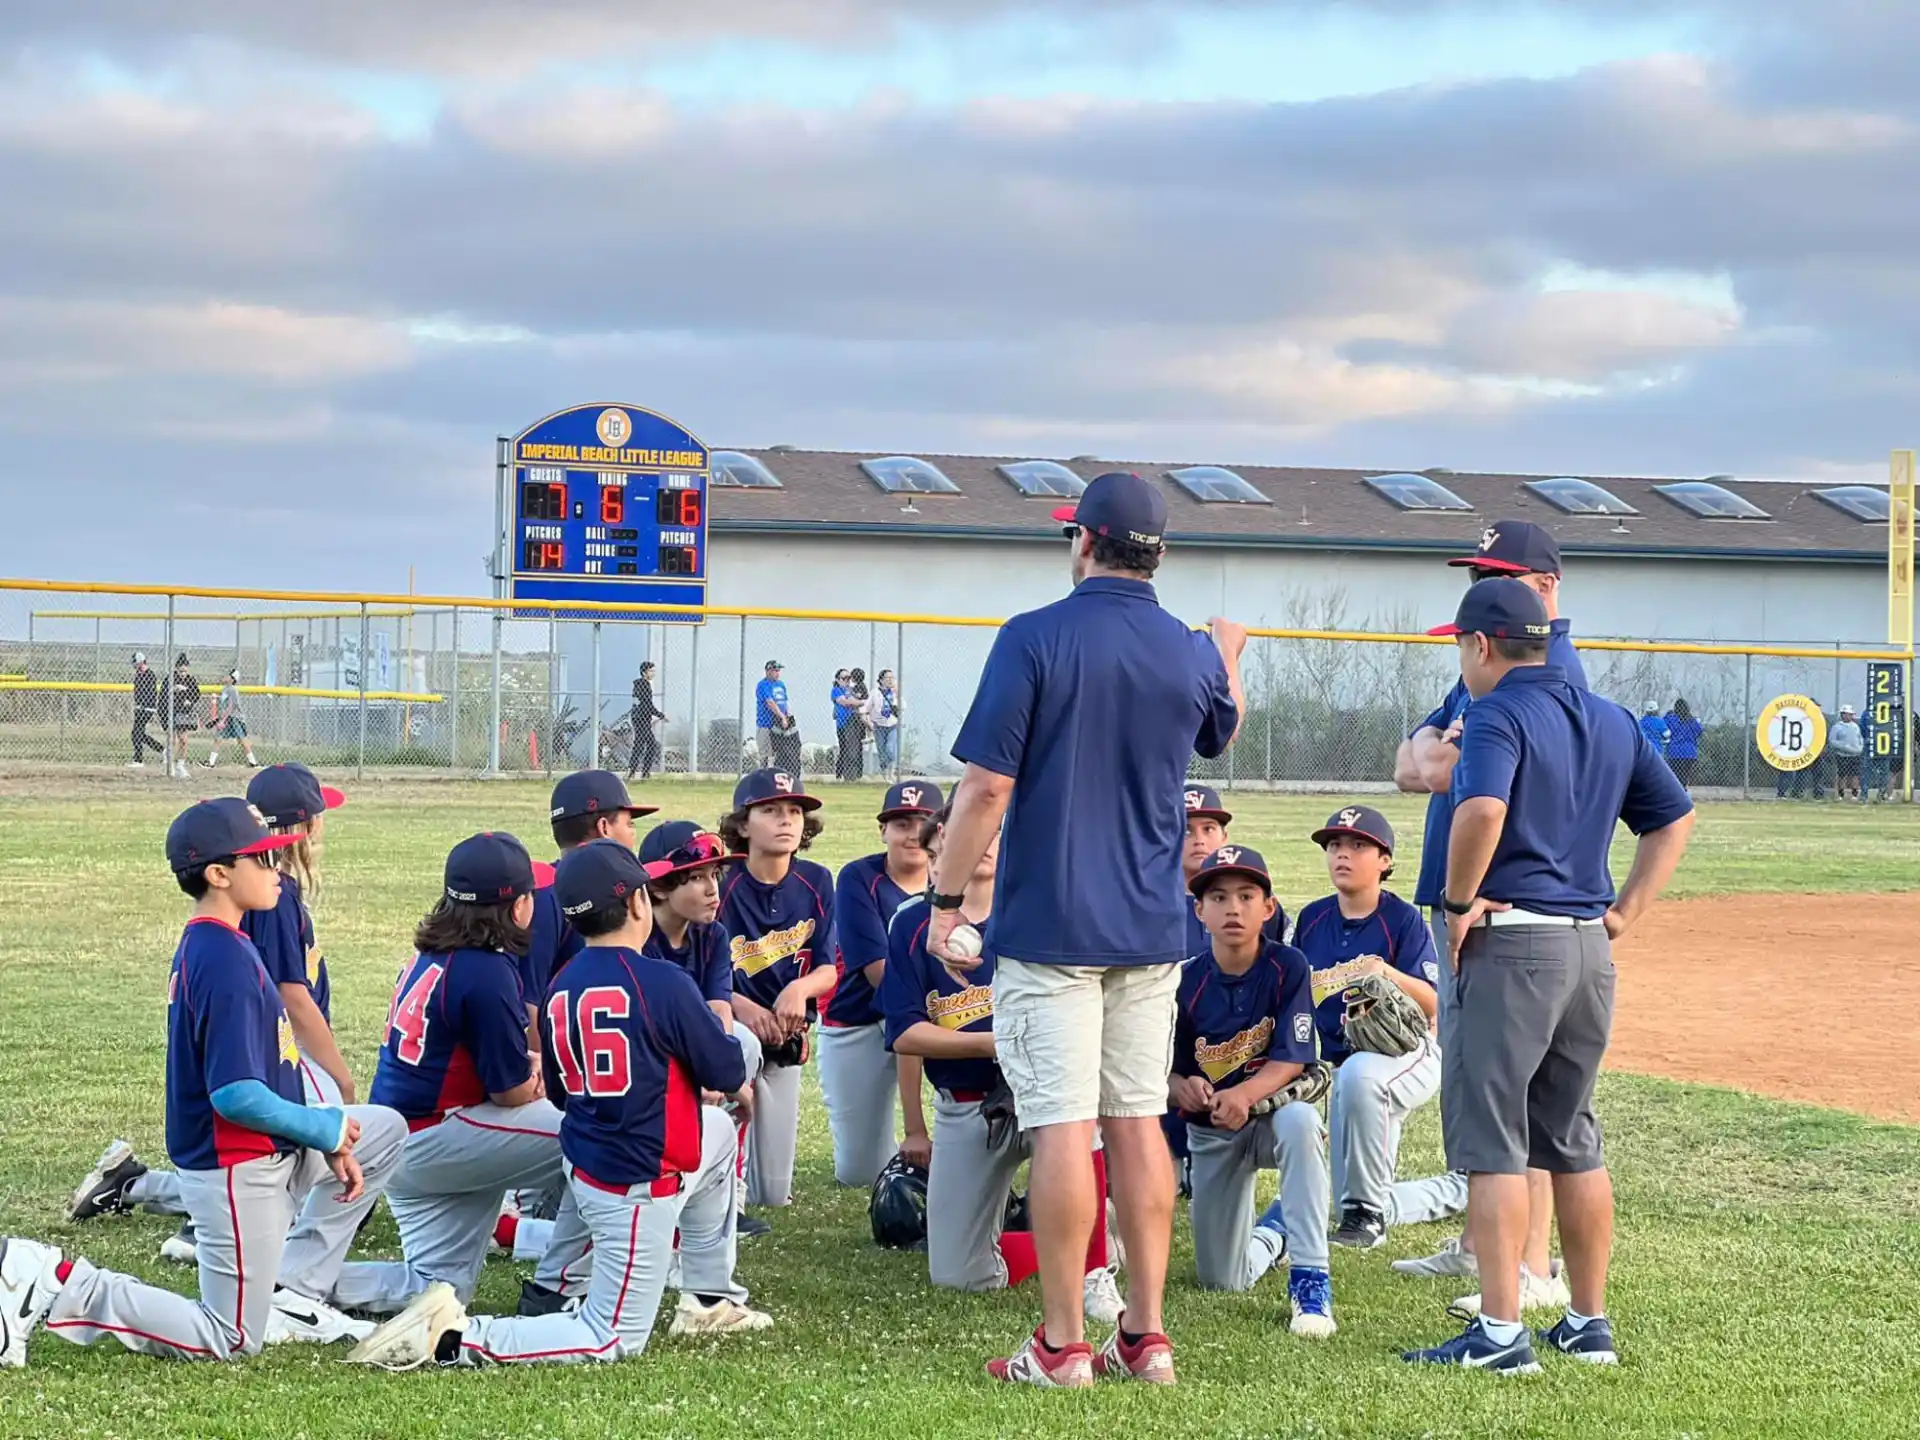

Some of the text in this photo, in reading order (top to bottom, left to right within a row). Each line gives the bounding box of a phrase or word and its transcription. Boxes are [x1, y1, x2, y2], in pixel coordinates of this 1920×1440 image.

[522, 444, 703, 466] IMPERIAL BEACH LITTLE LEAGUE
[530, 468, 562, 481] GUESTS
[668, 475, 691, 488] HOME
[548, 484, 566, 518] 7
[603, 487, 621, 522] 6
[681, 490, 699, 526] 6
[525, 526, 562, 539] PITCHES
[660, 532, 696, 544] PITCHES
[585, 561, 602, 574] OUT
[683, 548, 696, 573] 7
[1780, 715, 1803, 751] IB
[774, 773, 794, 793] SV
[901, 787, 924, 807] SV
[1338, 809, 1361, 827] SV
[1217, 847, 1241, 865] SV
[547, 986, 632, 1097] 16
